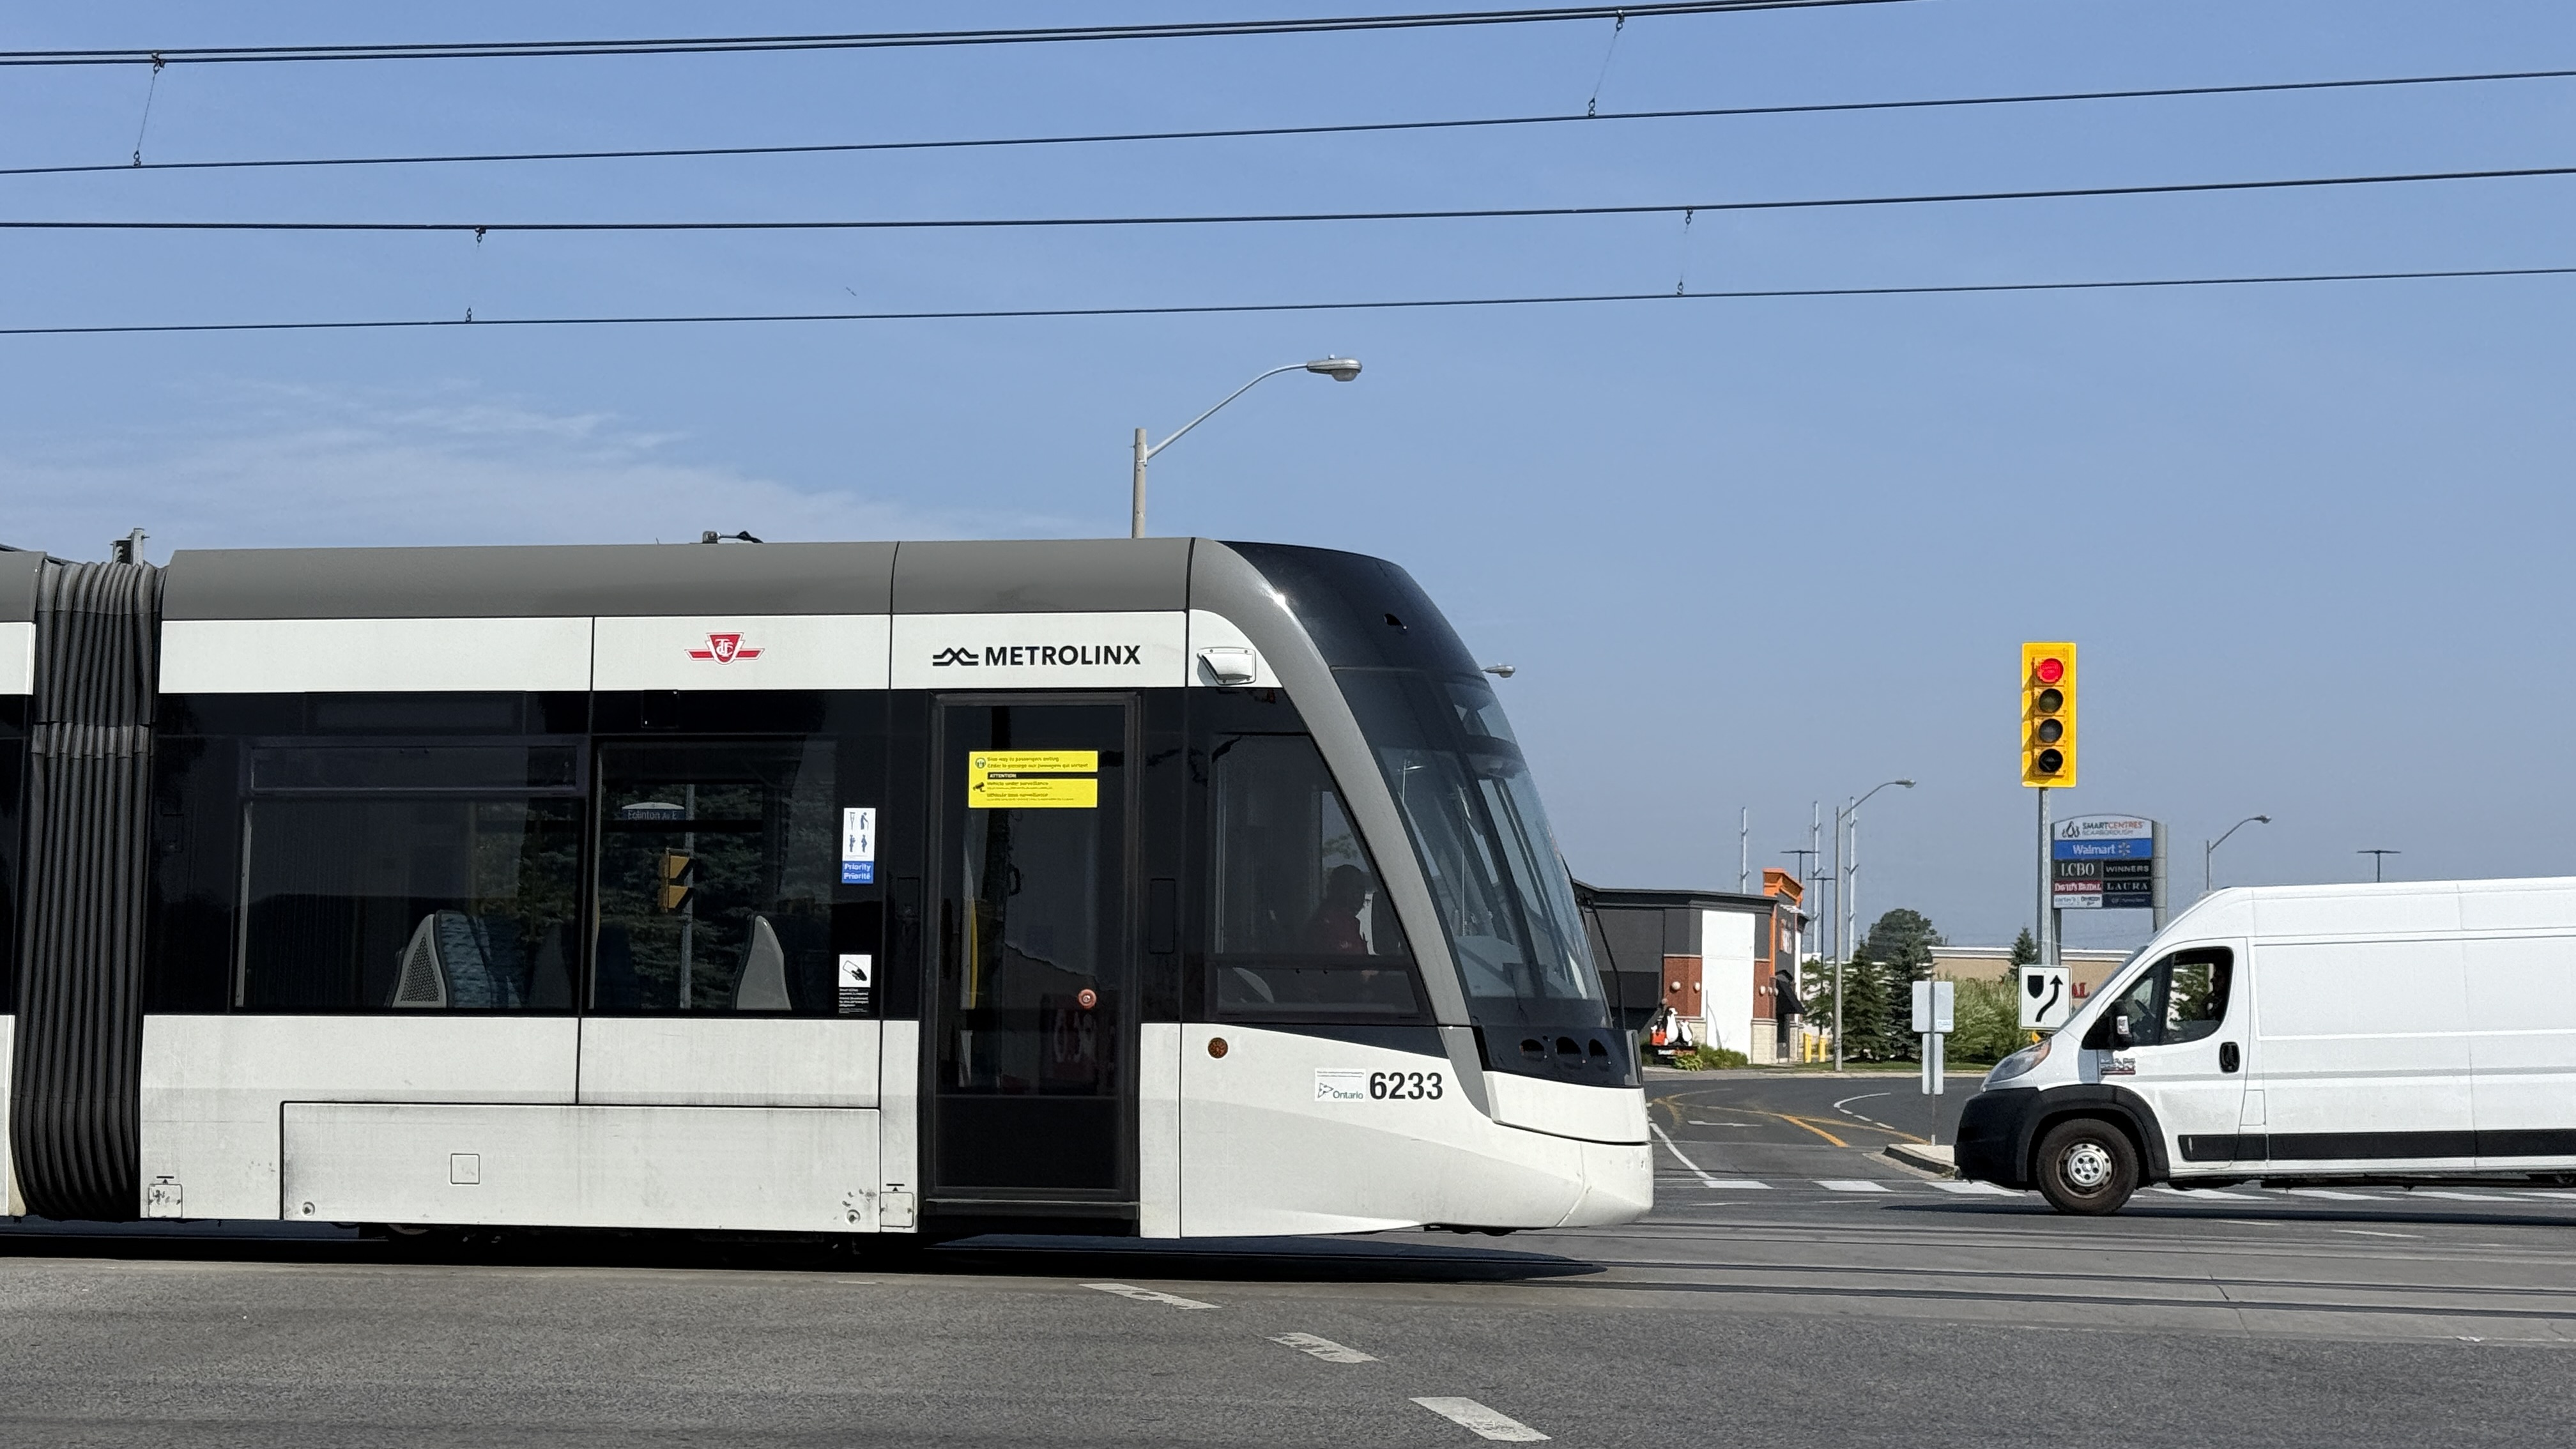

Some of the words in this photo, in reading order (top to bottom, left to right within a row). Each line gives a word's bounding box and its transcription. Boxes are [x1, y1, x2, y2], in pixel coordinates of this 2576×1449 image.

[986, 645, 1141, 666] METROLINX
[2073, 844, 2116, 855] Walmart
[845, 863, 871, 871] Priority
[2061, 862, 2095, 877] LCBO
[2107, 882, 2148, 891] LAURA
[1370, 1072, 1443, 1100] 6233
[1333, 1090, 1363, 1099] Ontario
